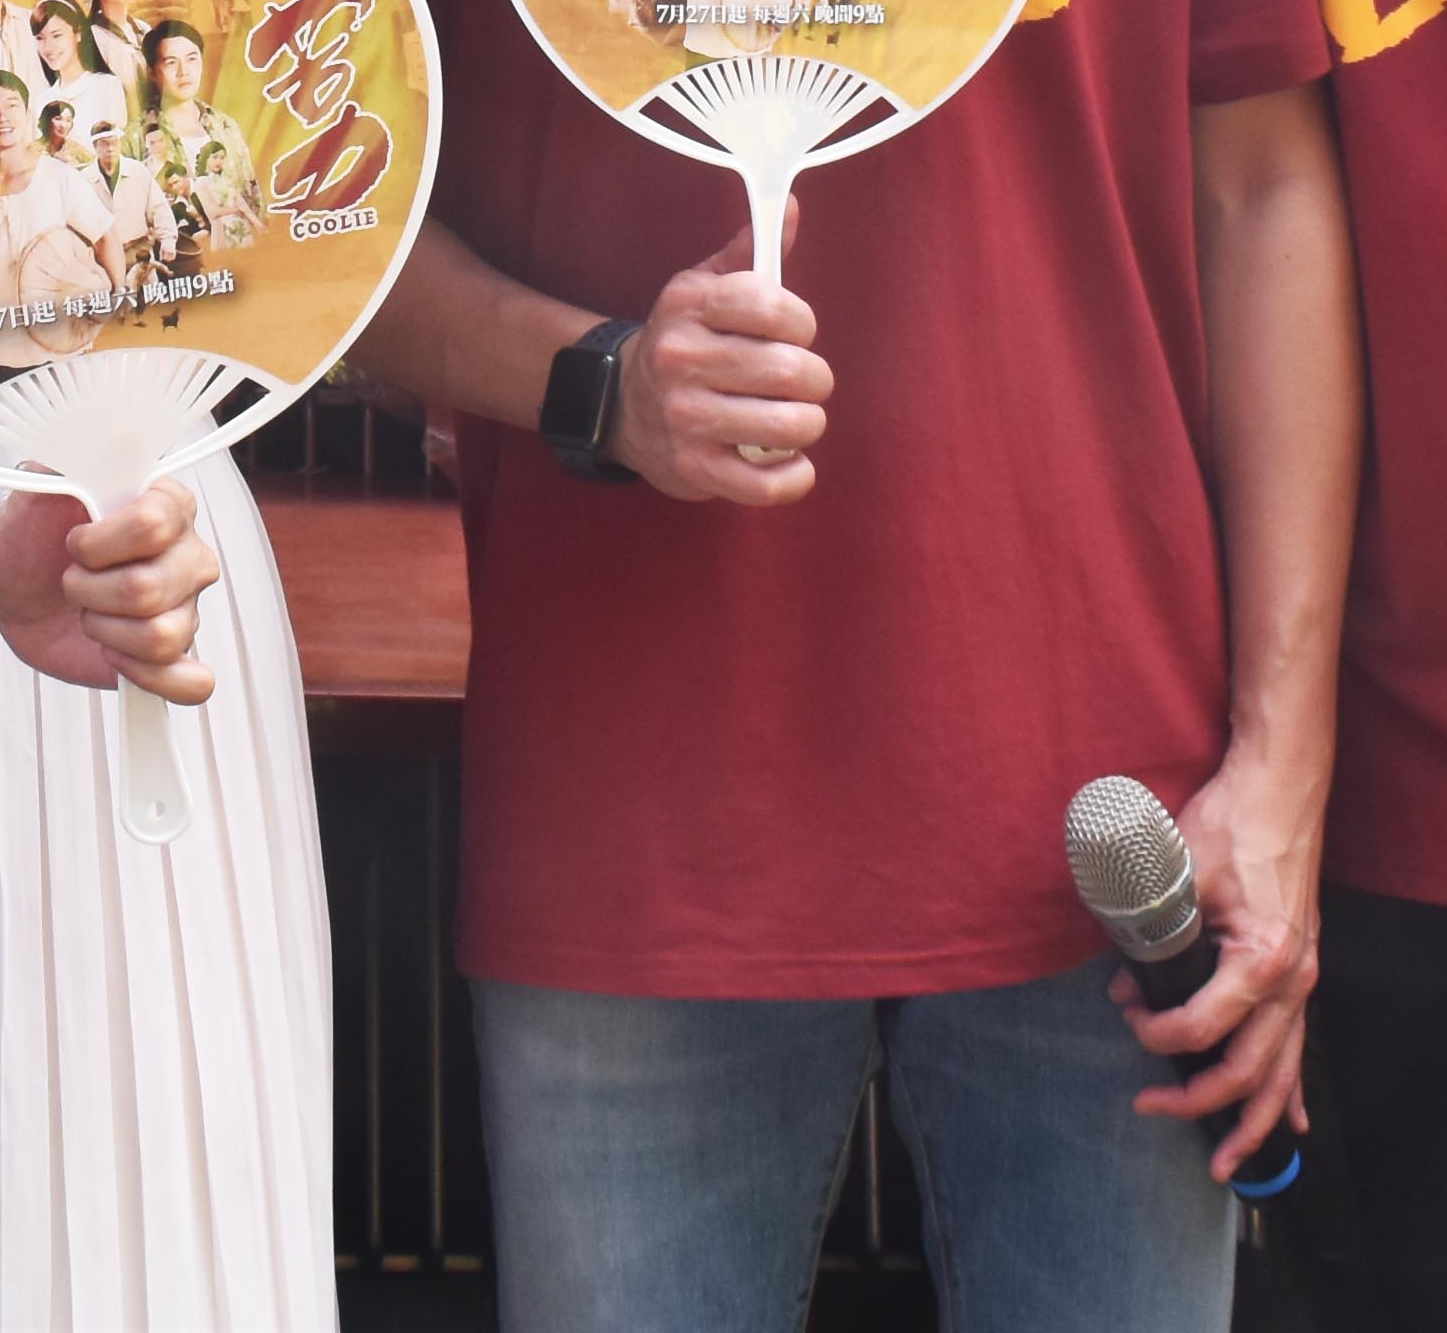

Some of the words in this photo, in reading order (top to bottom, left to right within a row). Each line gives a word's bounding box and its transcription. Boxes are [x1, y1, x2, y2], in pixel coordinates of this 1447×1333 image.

[656, 4, 747, 24] 7月27日起
[753, 4, 810, 24] 每週六
[814, 4, 885, 24] 晚間9點
[293, 210, 376, 238] COOLIE
[62, 286, 137, 318] 每週六
[142, 268, 234, 306] 晚間9點
